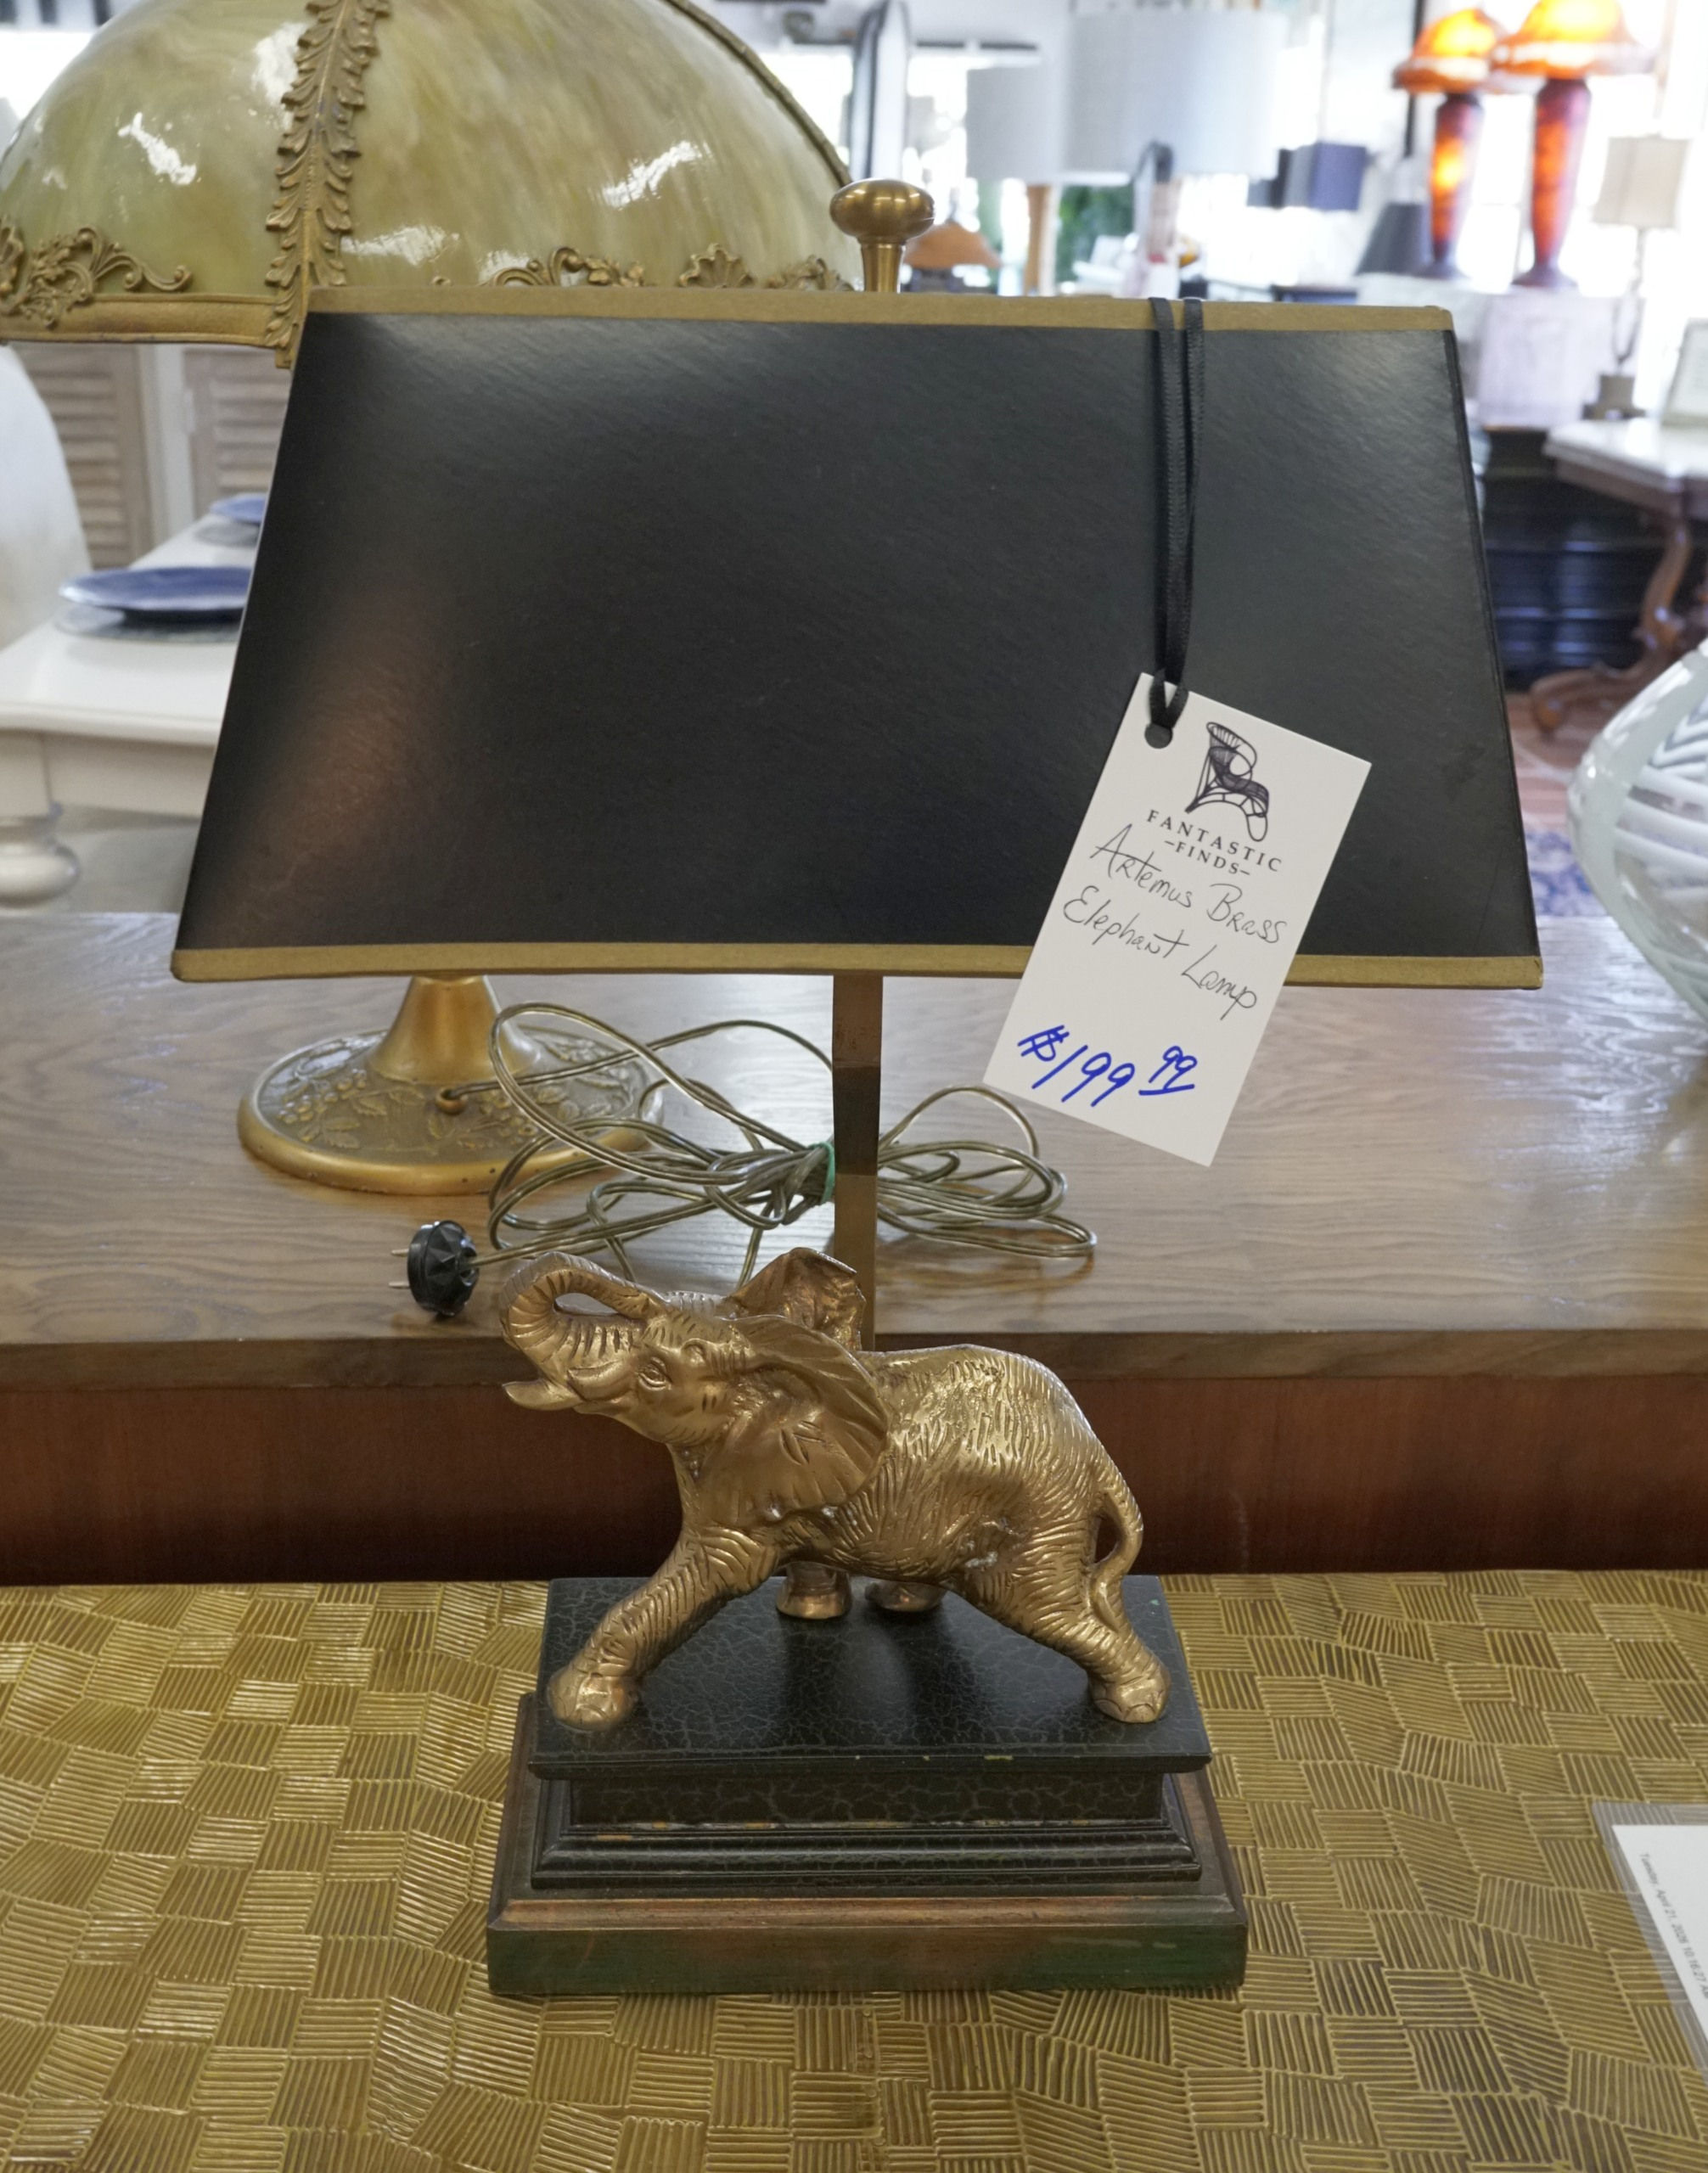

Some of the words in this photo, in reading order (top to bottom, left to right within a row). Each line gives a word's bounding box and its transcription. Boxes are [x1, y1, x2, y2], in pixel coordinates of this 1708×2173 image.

[1146, 809, 1283, 873] FANTASTIC
[1206, 883, 1288, 944] Brass
[1063, 884, 1190, 958] Elephant
[1181, 944, 1257, 1021] Lamp
